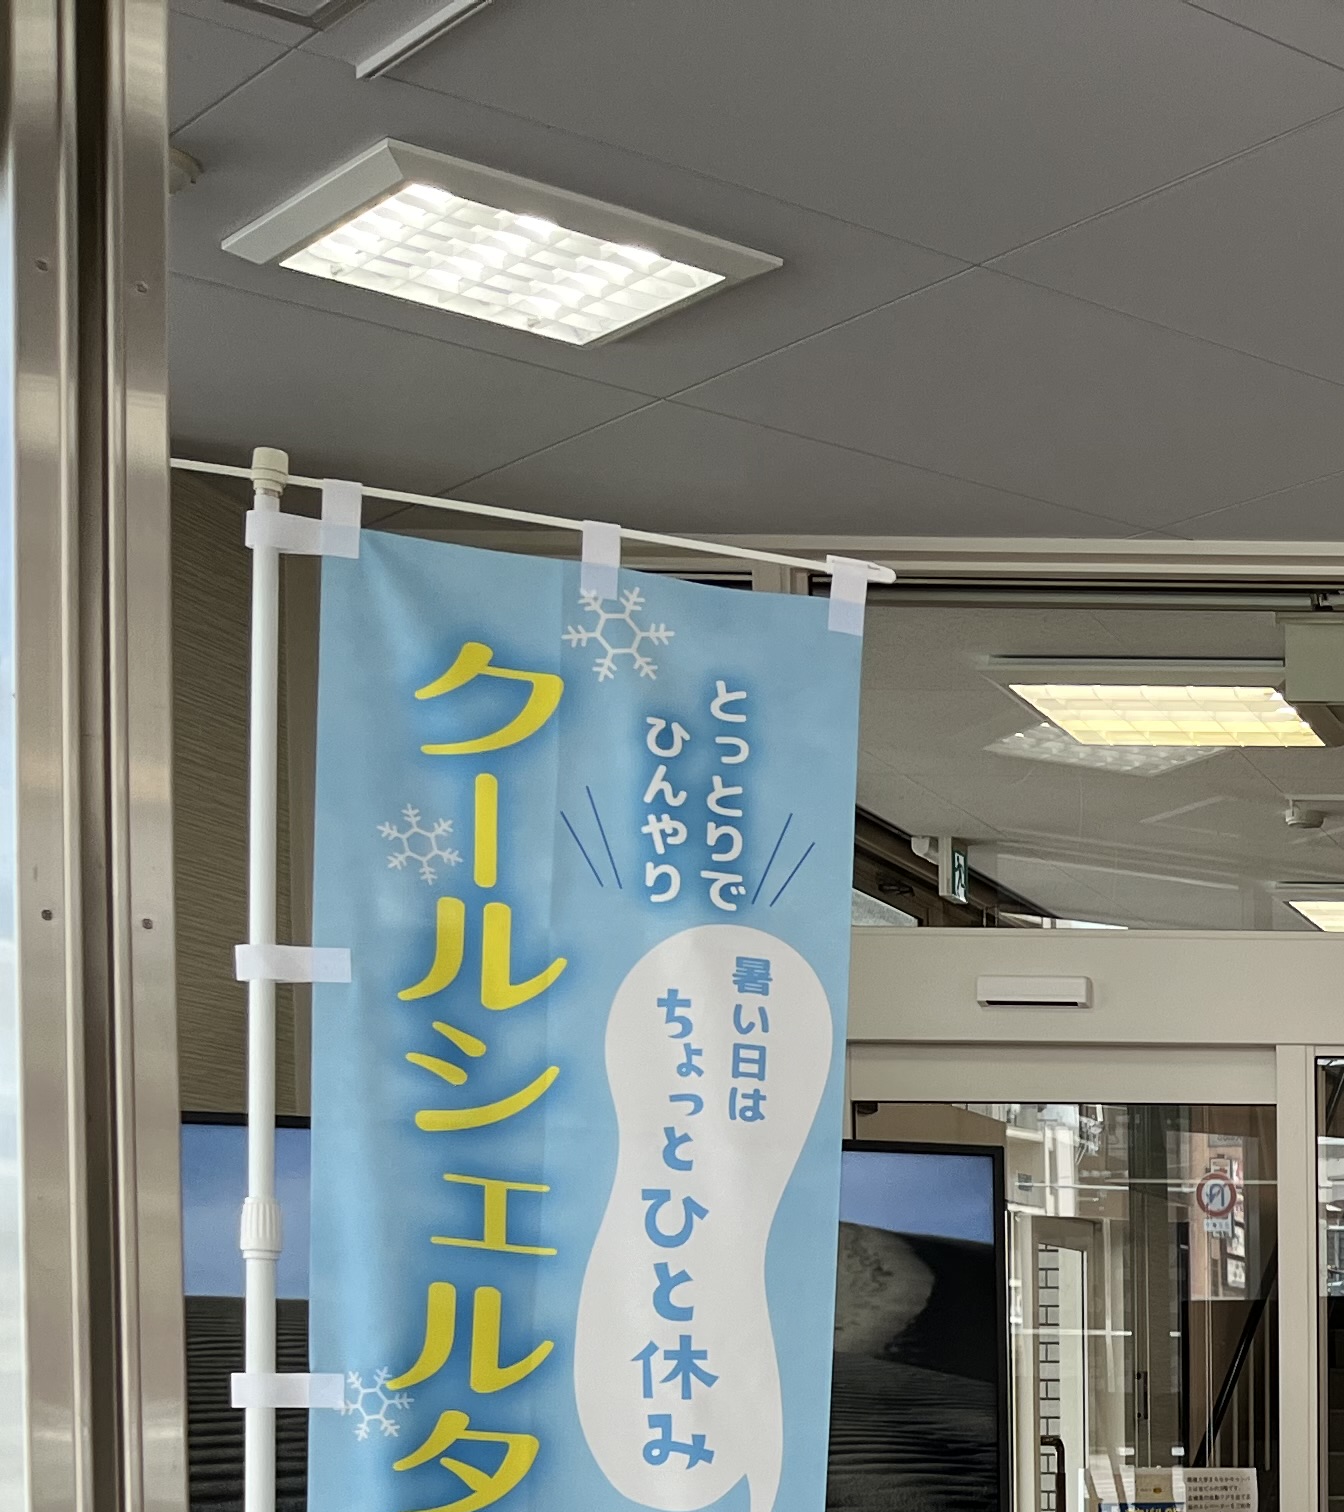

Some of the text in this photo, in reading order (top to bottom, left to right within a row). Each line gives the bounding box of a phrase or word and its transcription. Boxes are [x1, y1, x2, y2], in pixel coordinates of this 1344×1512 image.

[641, 716, 692, 904] ひんやり
[701, 681, 748, 912] とっとりで
[728, 956, 774, 1123] 暑い日は
[631, 988, 720, 1470] ちょっとひと休み
